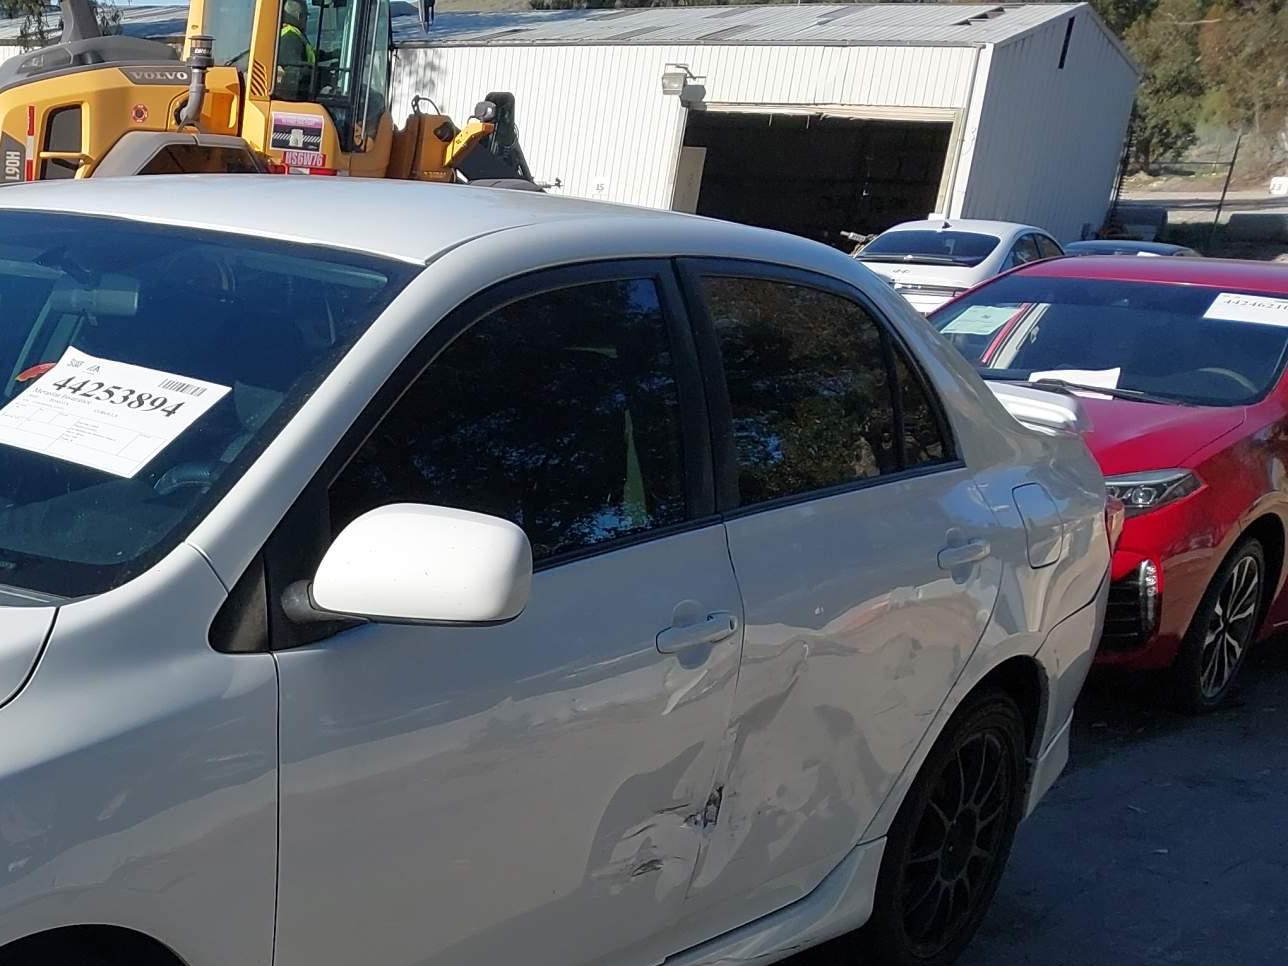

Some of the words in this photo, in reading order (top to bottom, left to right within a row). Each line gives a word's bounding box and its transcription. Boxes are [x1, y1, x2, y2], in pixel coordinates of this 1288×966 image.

[129, 71, 188, 80] VOLVO
[5, 151, 21, 181] L90H
[52, 376, 186, 418] 44253894
